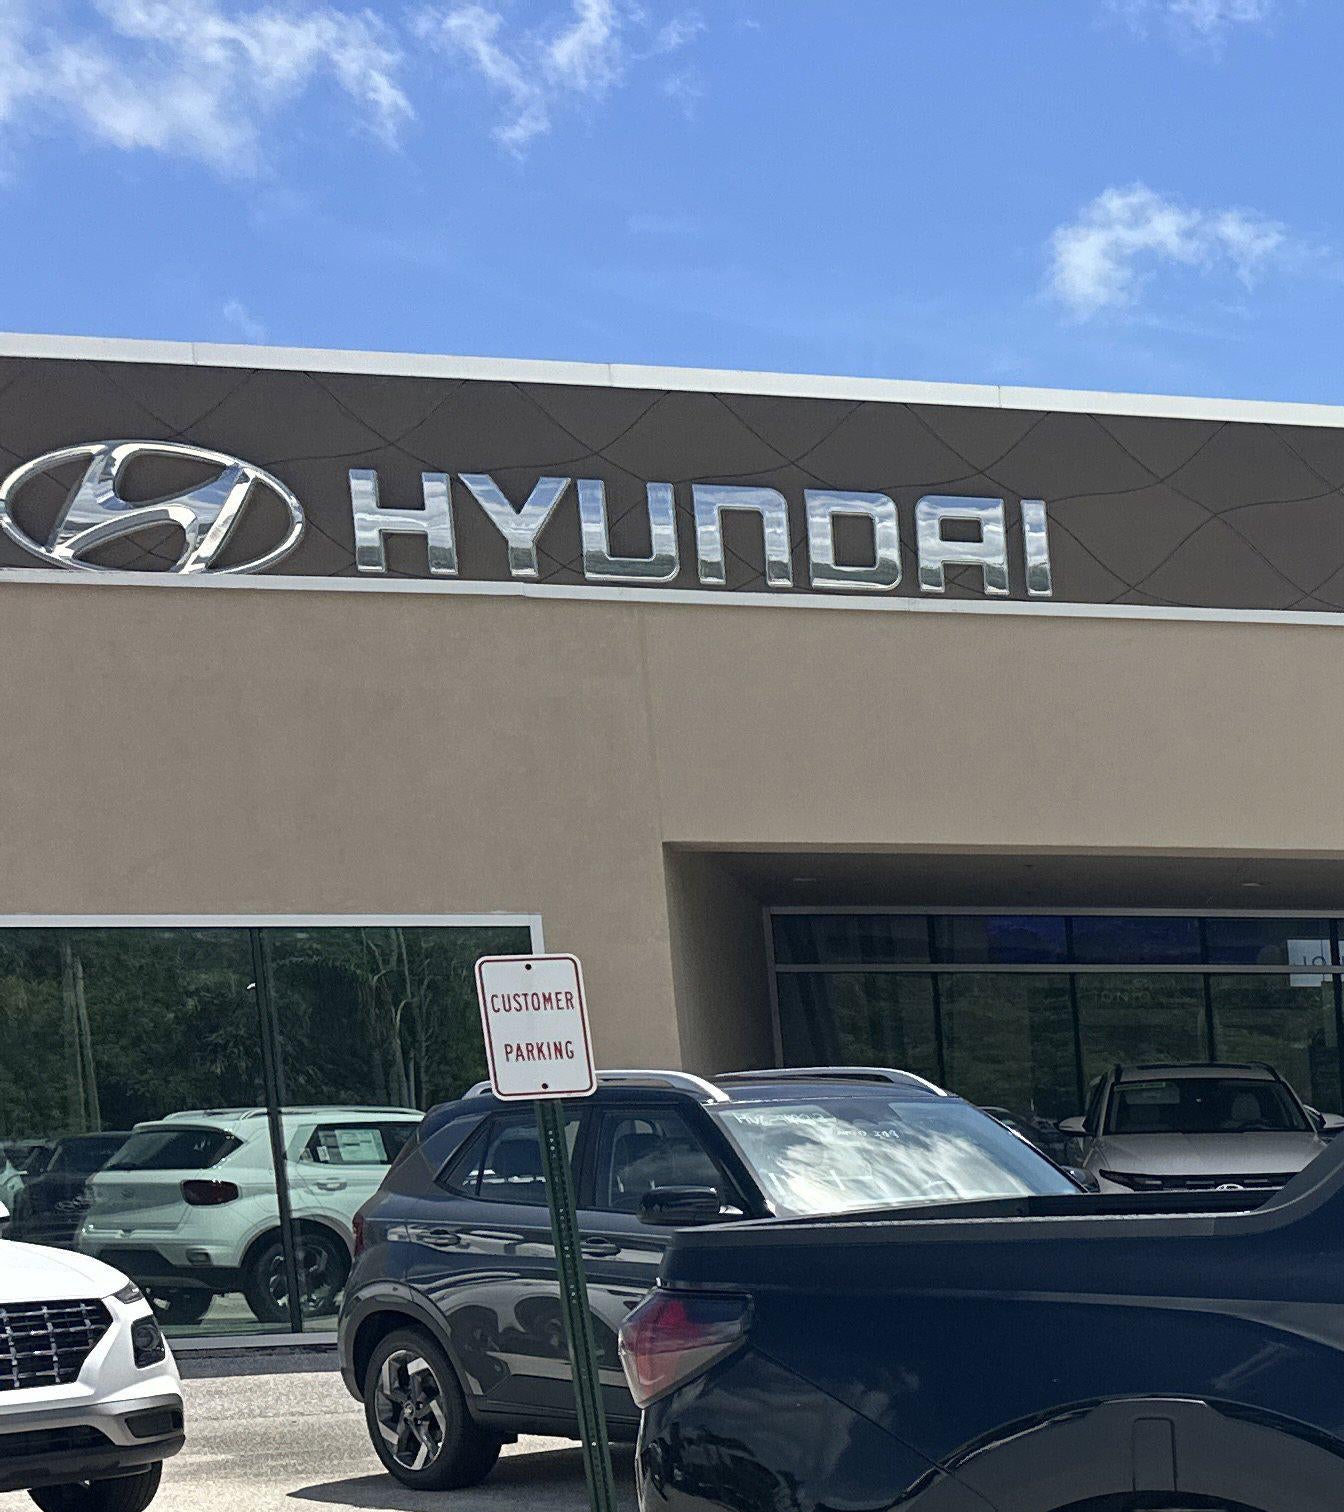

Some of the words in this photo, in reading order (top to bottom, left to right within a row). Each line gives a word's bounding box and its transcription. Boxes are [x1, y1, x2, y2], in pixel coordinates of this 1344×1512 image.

[348, 468, 1052, 597] HYUNDAI
[490, 991, 575, 1013] CUSTOMER
[504, 1041, 575, 1062] PARKING
